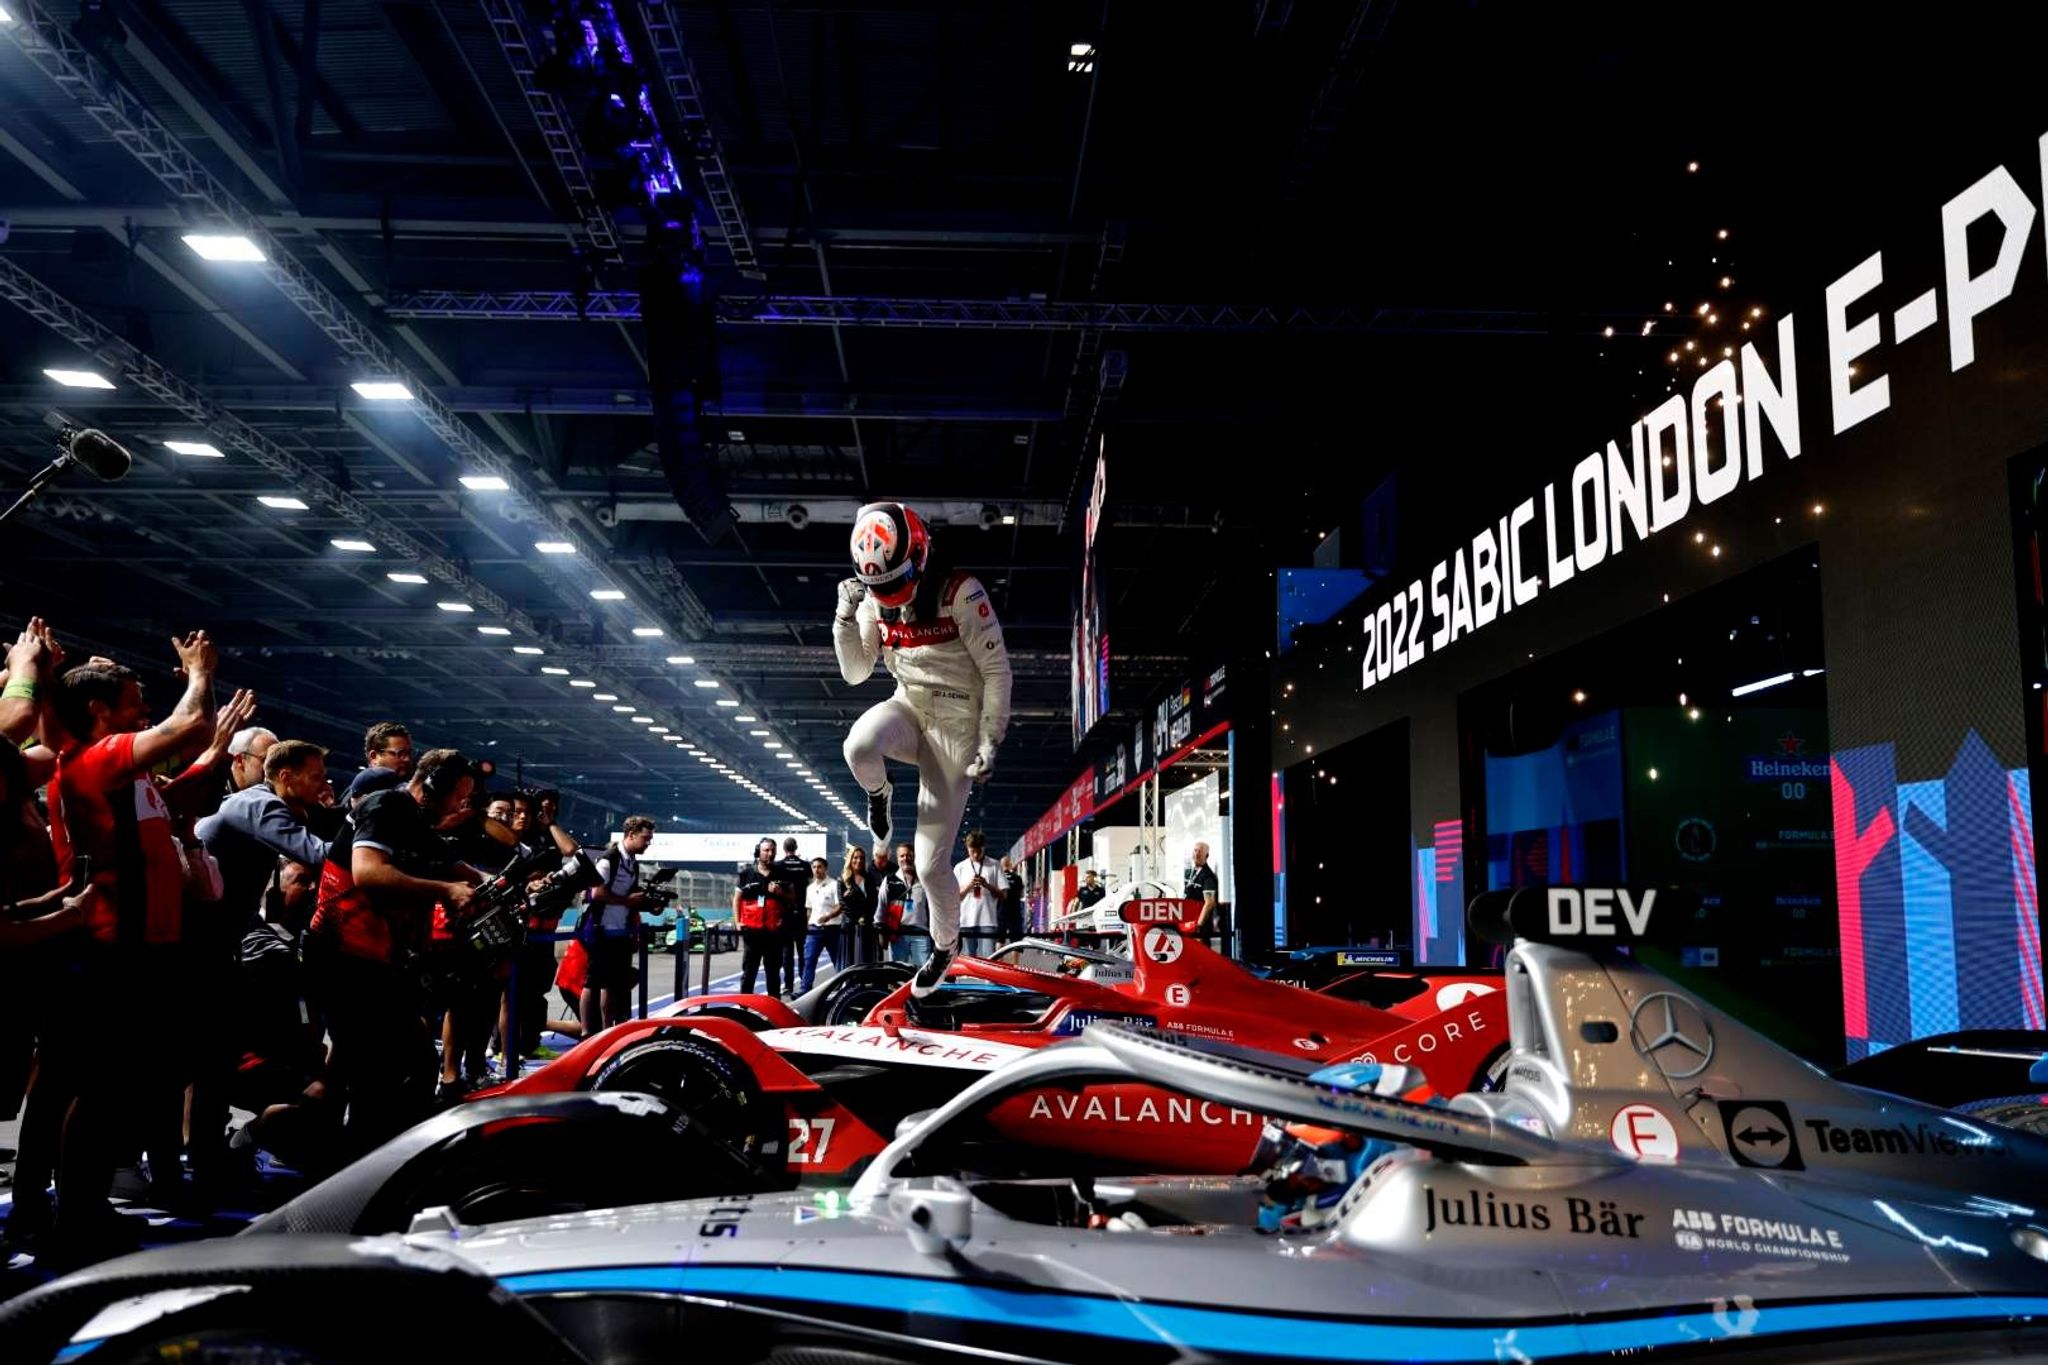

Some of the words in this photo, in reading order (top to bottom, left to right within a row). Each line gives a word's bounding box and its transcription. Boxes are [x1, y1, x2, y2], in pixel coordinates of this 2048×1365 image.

[1363, 580, 1424, 689] 2022
[1432, 498, 1541, 651] SABIC
[1545, 313, 1800, 588] LONDON
[1826, 132, 2048, 435] E-P
[1751, 759, 1830, 777] Heineken
[1140, 902, 1183, 921] DEN
[1548, 889, 1655, 934] DEV
[1094, 968, 1122, 978] Julius
[1172, 987, 1185, 1004] E
[1069, 1014, 1098, 1031] Juli
[1186, 1023, 1226, 1036] FORMULA
[1395, 1012, 1486, 1062] CORE
[1031, 1094, 1283, 1126] AVALANCH
[788, 1118, 835, 1164] 27
[1426, 1187, 1551, 1232] Julius
[1566, 1197, 1645, 1239] Bär
[1672, 1208, 1716, 1231] ABB
[1721, 1214, 1825, 1246] FORMULA
[1826, 1230, 1843, 1248] E
[1705, 1238, 1751, 1252] WORLD
[1754, 1243, 1850, 1263] CHAMPIONSHIP
